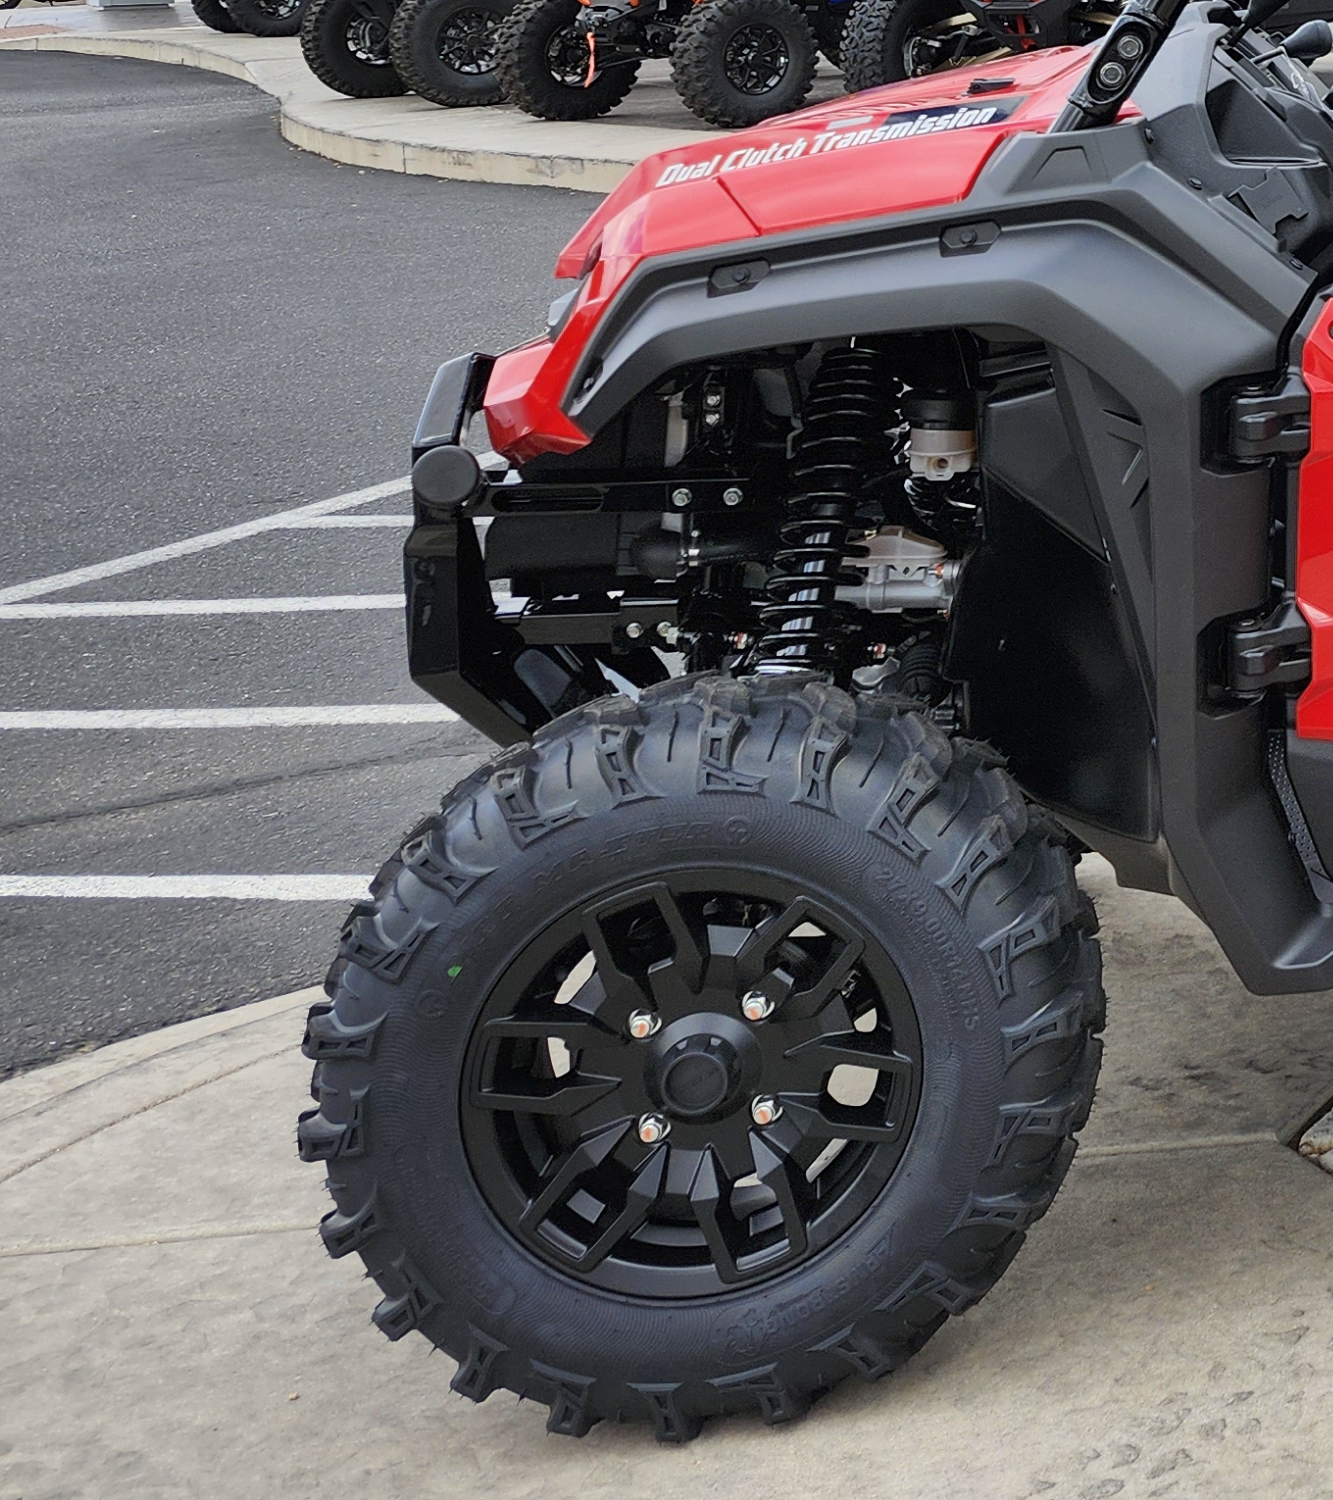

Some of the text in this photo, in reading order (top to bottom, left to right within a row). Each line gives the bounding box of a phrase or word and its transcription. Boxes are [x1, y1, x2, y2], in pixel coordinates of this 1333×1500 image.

[655, 104, 998, 188] Dual Clutch Transmission
